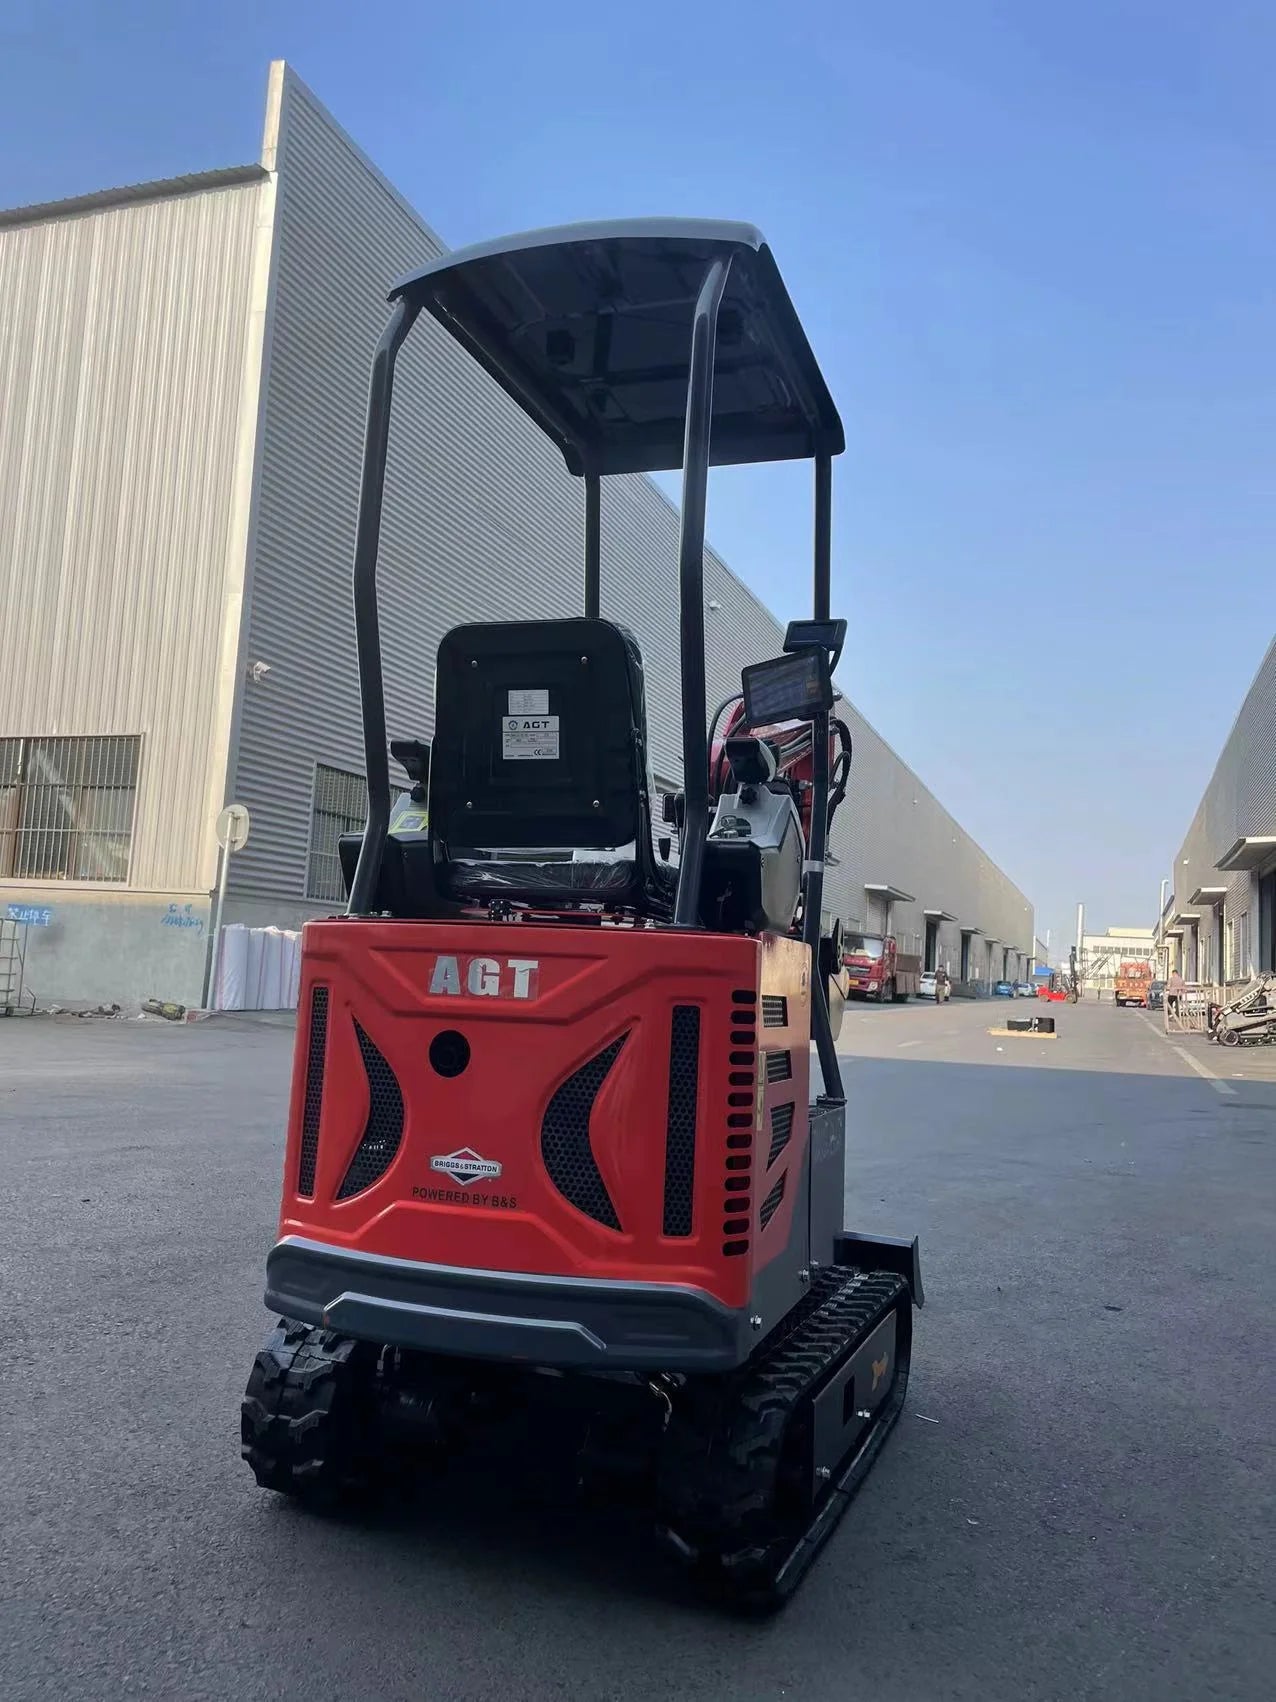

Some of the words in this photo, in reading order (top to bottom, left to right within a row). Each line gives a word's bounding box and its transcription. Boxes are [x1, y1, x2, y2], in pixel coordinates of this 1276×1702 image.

[429, 956, 539, 998] AGT
[412, 1187, 469, 1202] POWERED
[473, 1194, 489, 1205] BY
[491, 1195, 517, 1208] B&S
